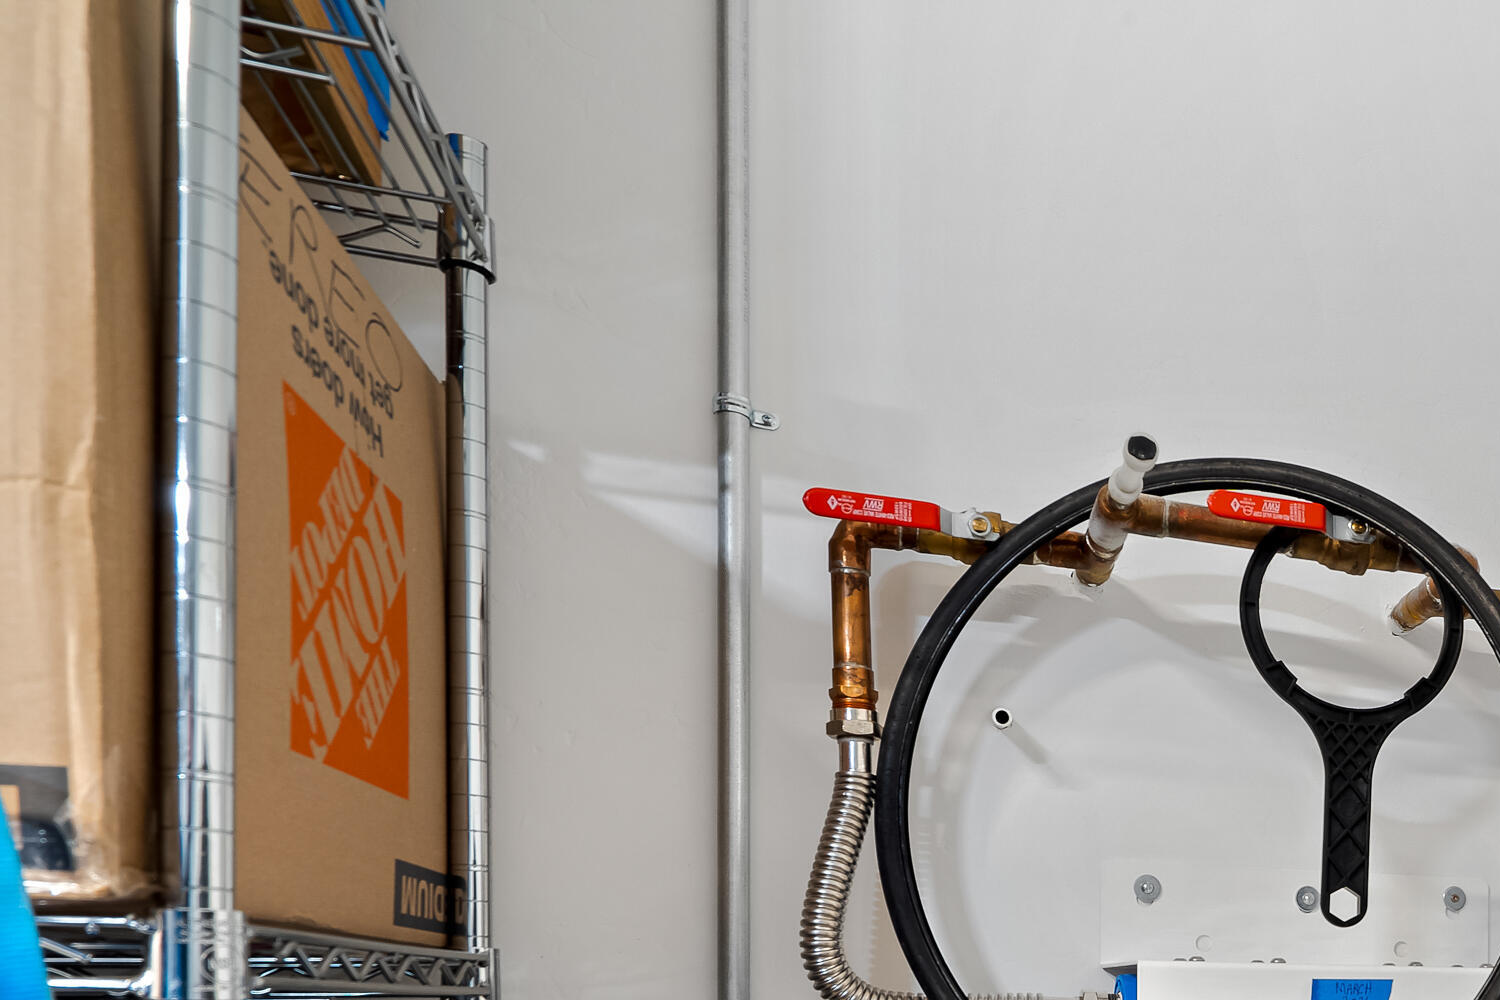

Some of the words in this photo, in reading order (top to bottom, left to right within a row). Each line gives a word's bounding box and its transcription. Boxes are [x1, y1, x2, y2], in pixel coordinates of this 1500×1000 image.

[291, 324, 345, 408] doers
[323, 317, 366, 388] more
[350, 392, 384, 459] How
[290, 447, 366, 620] DEPOT
[290, 483, 406, 762] HOME
[356, 636, 400, 751] THE
[1335, 982, 1372, 996] MARCH
